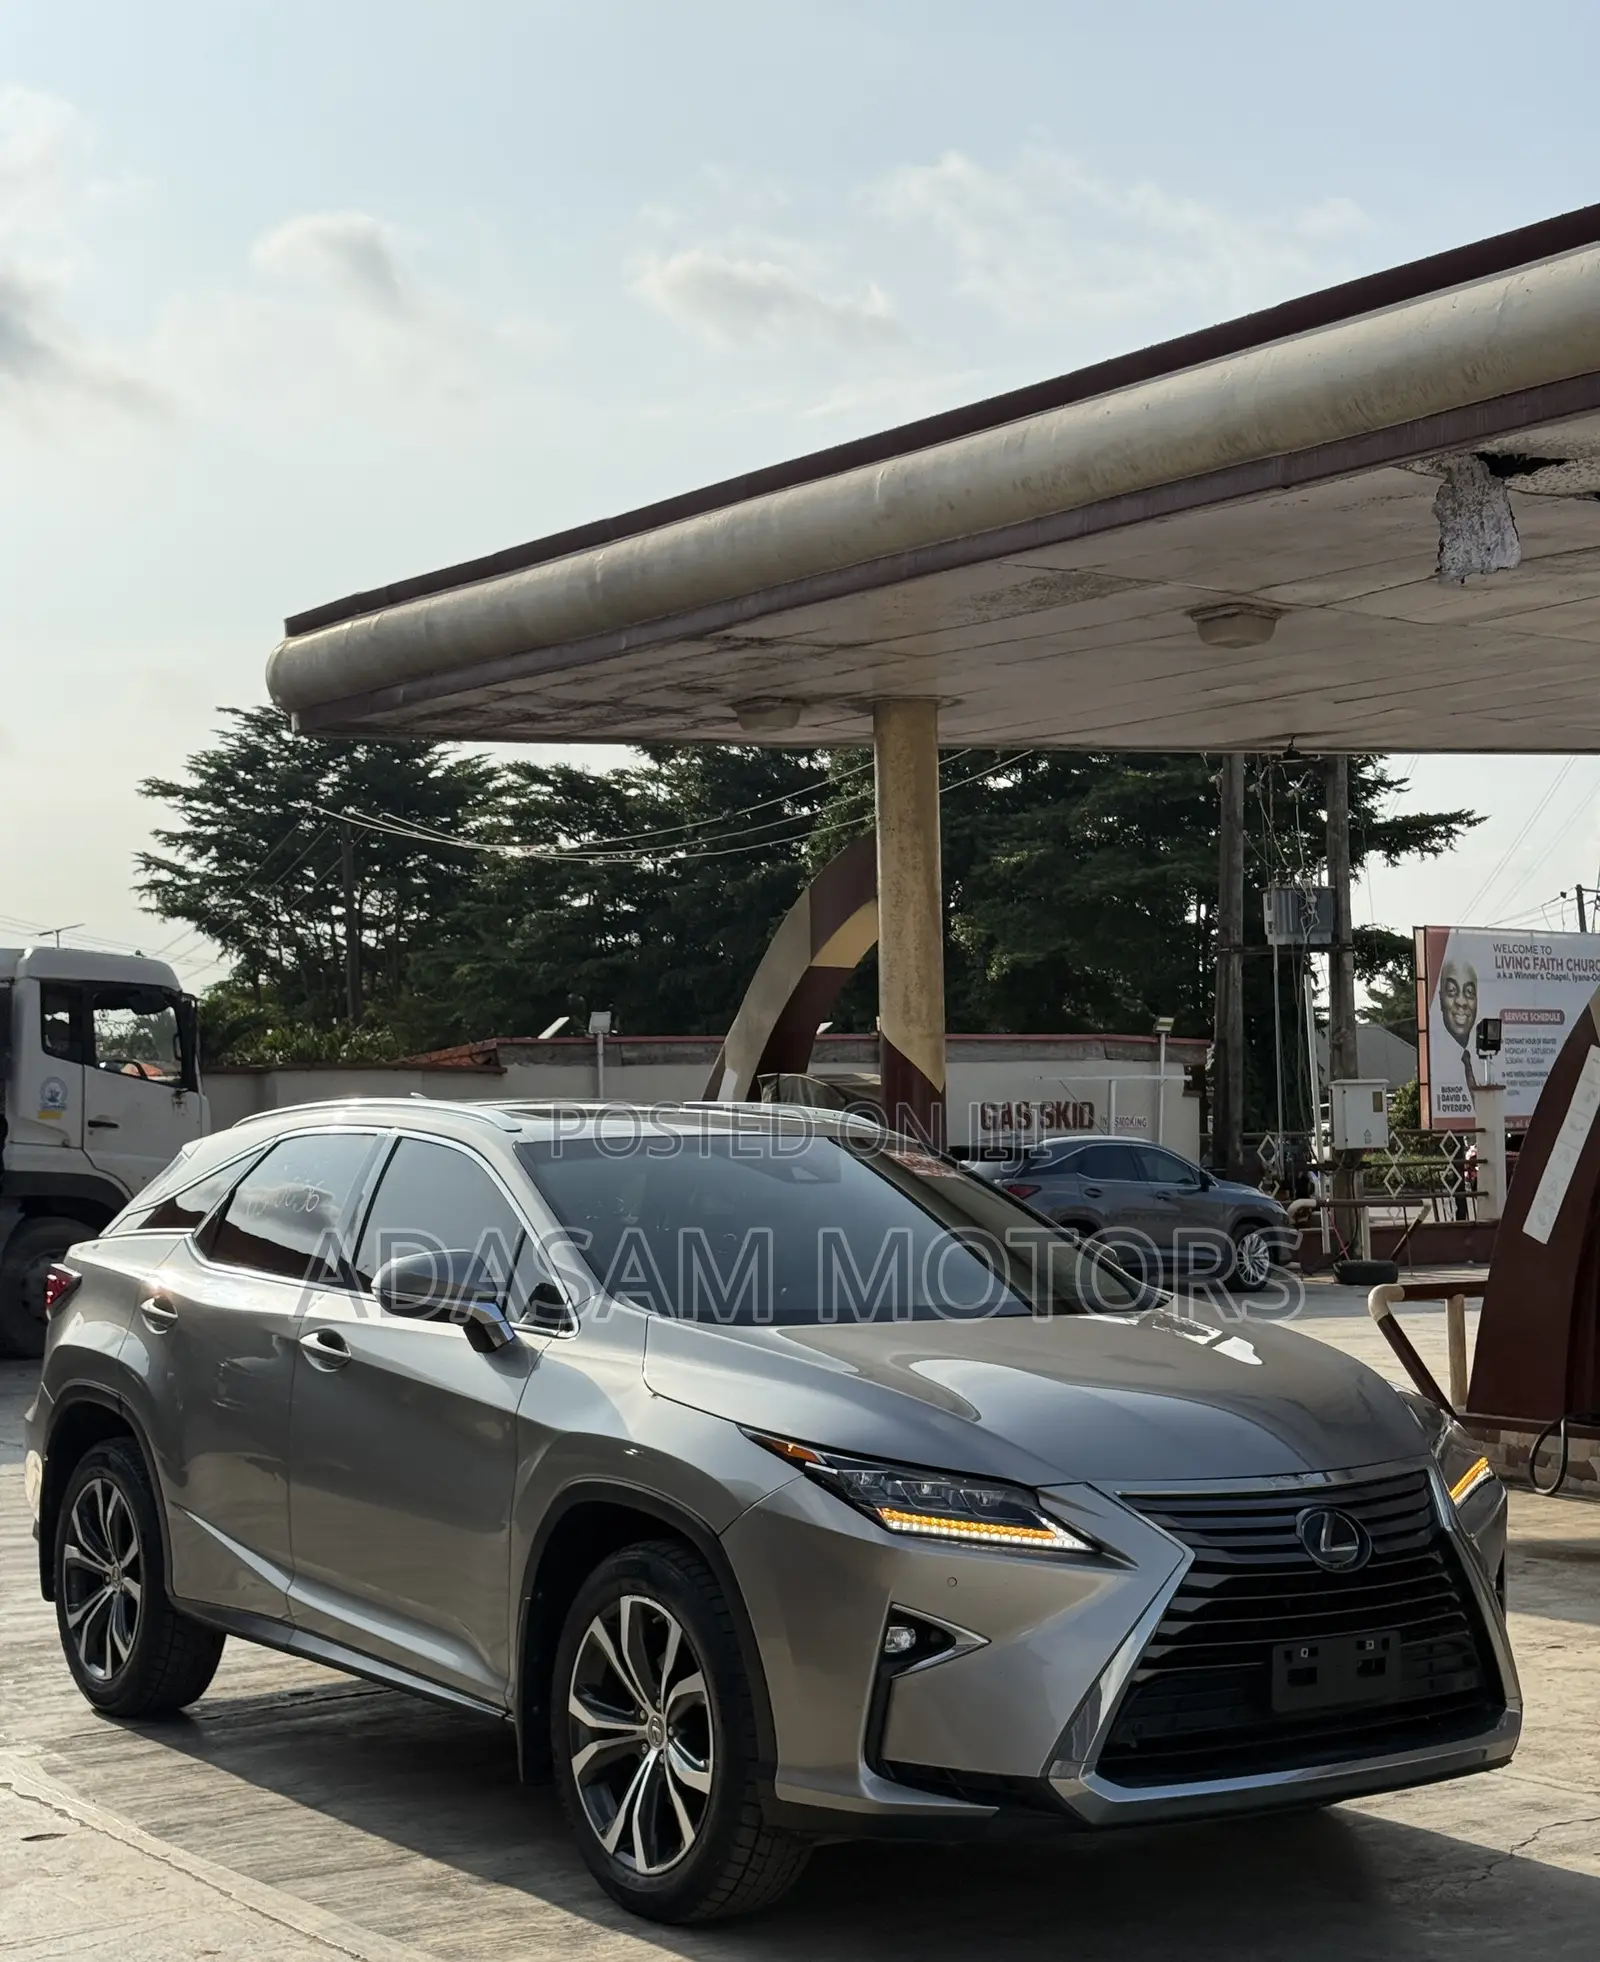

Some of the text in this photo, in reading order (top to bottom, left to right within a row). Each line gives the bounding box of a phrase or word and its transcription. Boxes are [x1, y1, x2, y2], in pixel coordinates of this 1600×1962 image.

[1493, 944, 1552, 955] WELCOME TO
[1495, 955, 1530, 970] LIVING
[1533, 957, 1563, 971] FAITH
[1514, 971, 1544, 980] Winner's
[1504, 1012, 1560, 1022] SERVICE SCHEDULE
[1442, 1104, 1471, 1112] OYEDEPO
[980, 1101, 1095, 1131] GAS SKID
[1114, 1116, 1147, 1128] SMOKING
